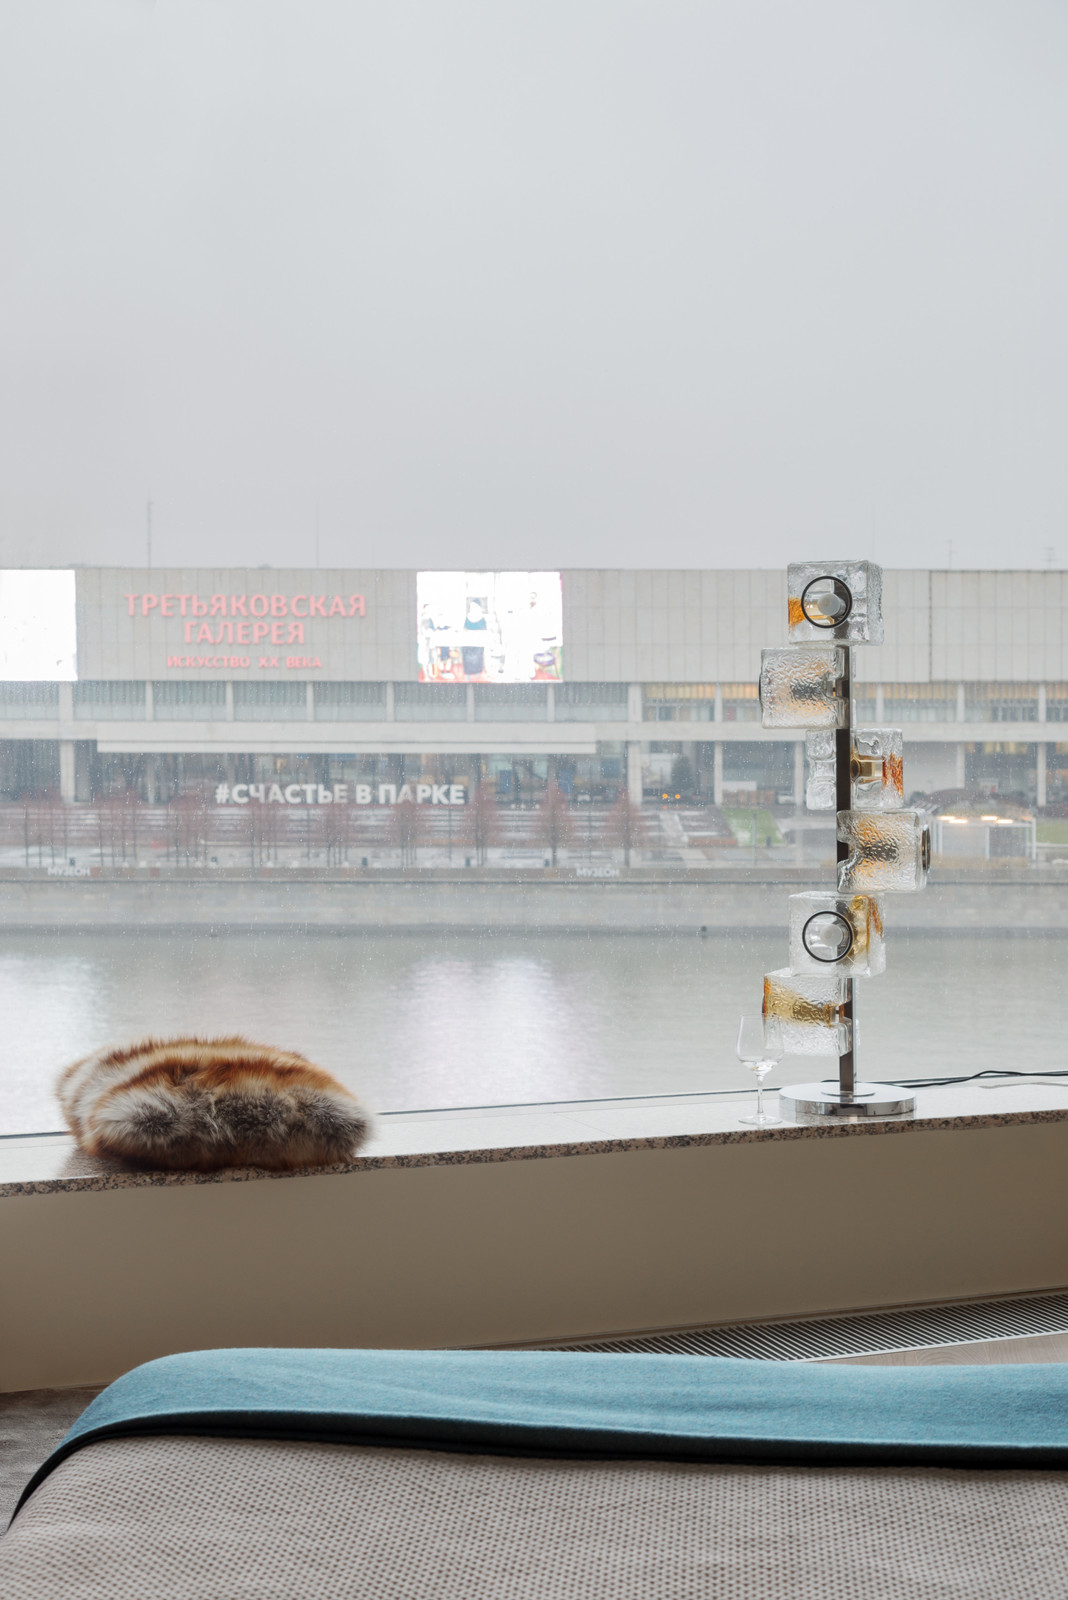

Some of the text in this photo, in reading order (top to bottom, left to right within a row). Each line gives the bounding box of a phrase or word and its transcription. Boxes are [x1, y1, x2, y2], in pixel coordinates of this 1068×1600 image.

[125, 594, 366, 617] ТРЕТЬЯКОВСКАЯ
[184, 622, 305, 645] ГАЛЕРЕЯ
[167, 656, 250, 669] ИСКУССТВО
[286, 656, 322, 668] ВЕКА
[215, 784, 465, 805] #СЧАСТЬЕ В ПАРКЕ
